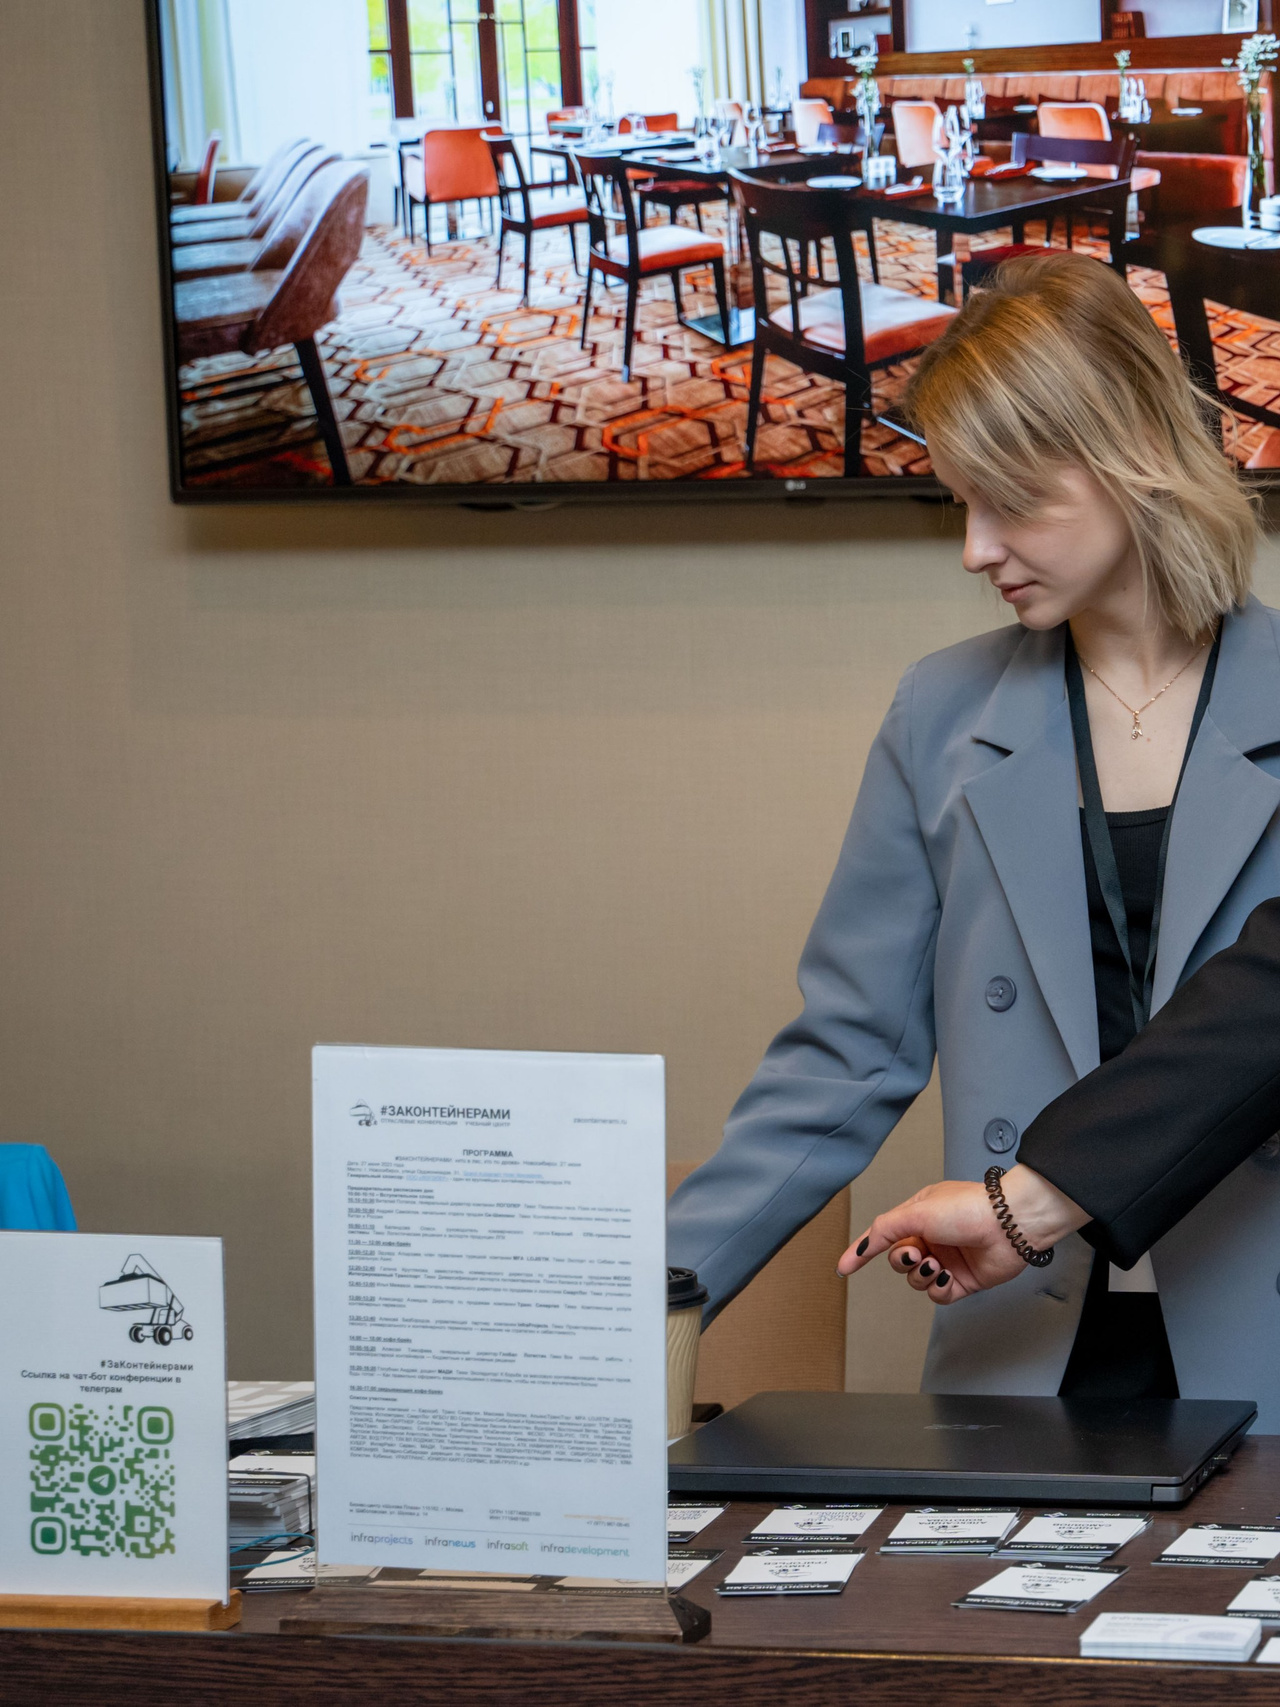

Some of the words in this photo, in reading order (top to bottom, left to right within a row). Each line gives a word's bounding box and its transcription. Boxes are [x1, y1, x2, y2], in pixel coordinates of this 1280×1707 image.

[380, 1105, 511, 1120] #ЗАКОНТЕЙНЕРАМИ
[462, 1149, 514, 1158] ПРОГРАММА
[100, 1360, 194, 1372] #ЗаКонтейнерами
[21, 1370, 57, 1379] Ссылка
[73, 1371, 107, 1380] чат-бот
[110, 1374, 173, 1383] конференции
[79, 1385, 123, 1394] телеграм
[350, 1532, 414, 1546] infraprojects
[424, 1535, 477, 1548] infranews
[487, 1538, 529, 1551] infrasoft
[540, 1541, 630, 1557] infradevelopment
